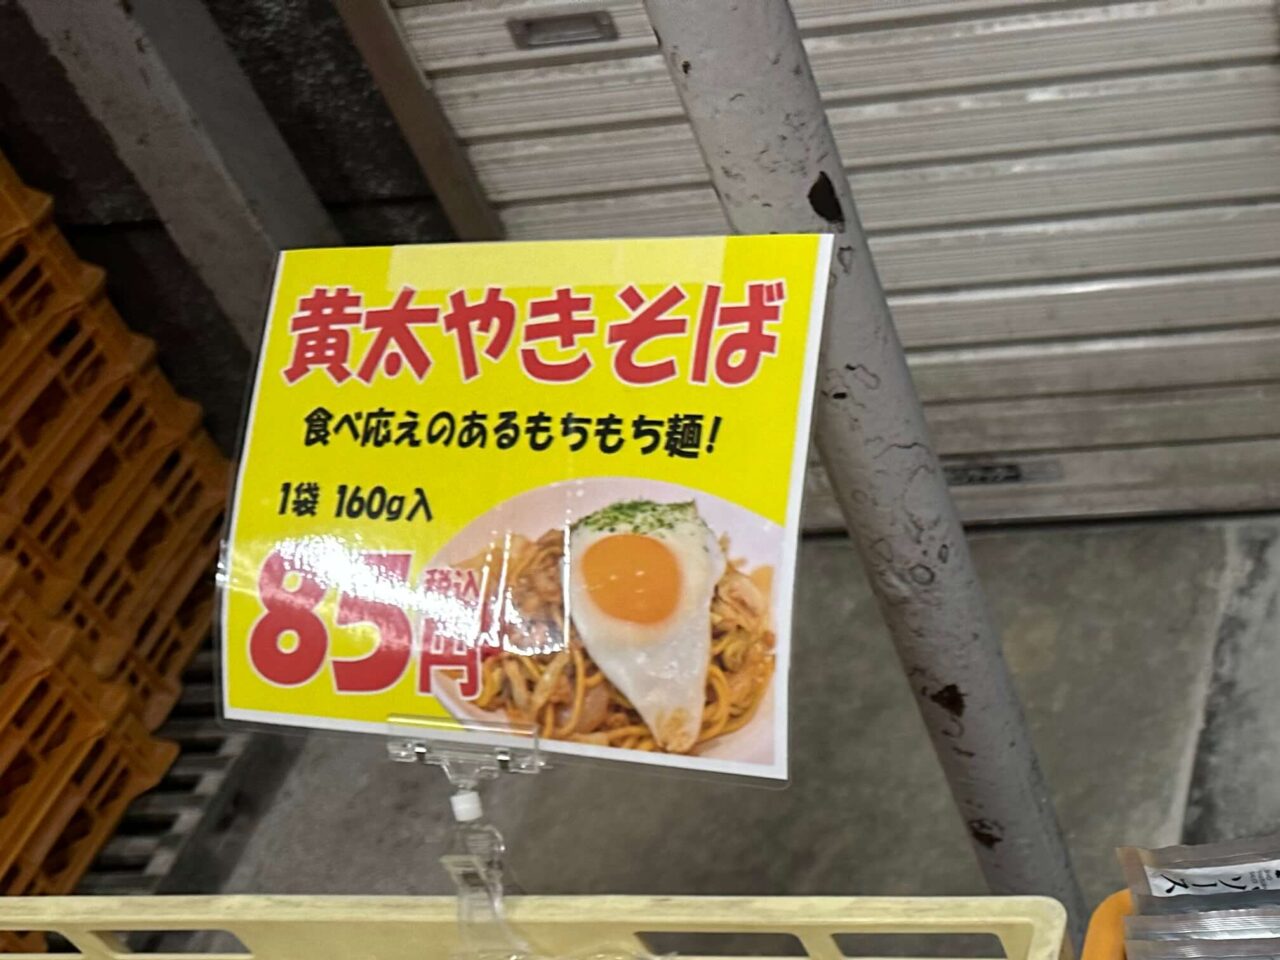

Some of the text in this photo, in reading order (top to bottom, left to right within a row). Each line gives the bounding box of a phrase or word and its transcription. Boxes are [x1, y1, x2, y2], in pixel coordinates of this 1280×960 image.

[281, 281, 786, 388] 黄太やきそば
[279, 482, 434, 523] 1袋 160g入
[249, 550, 413, 694] 85
